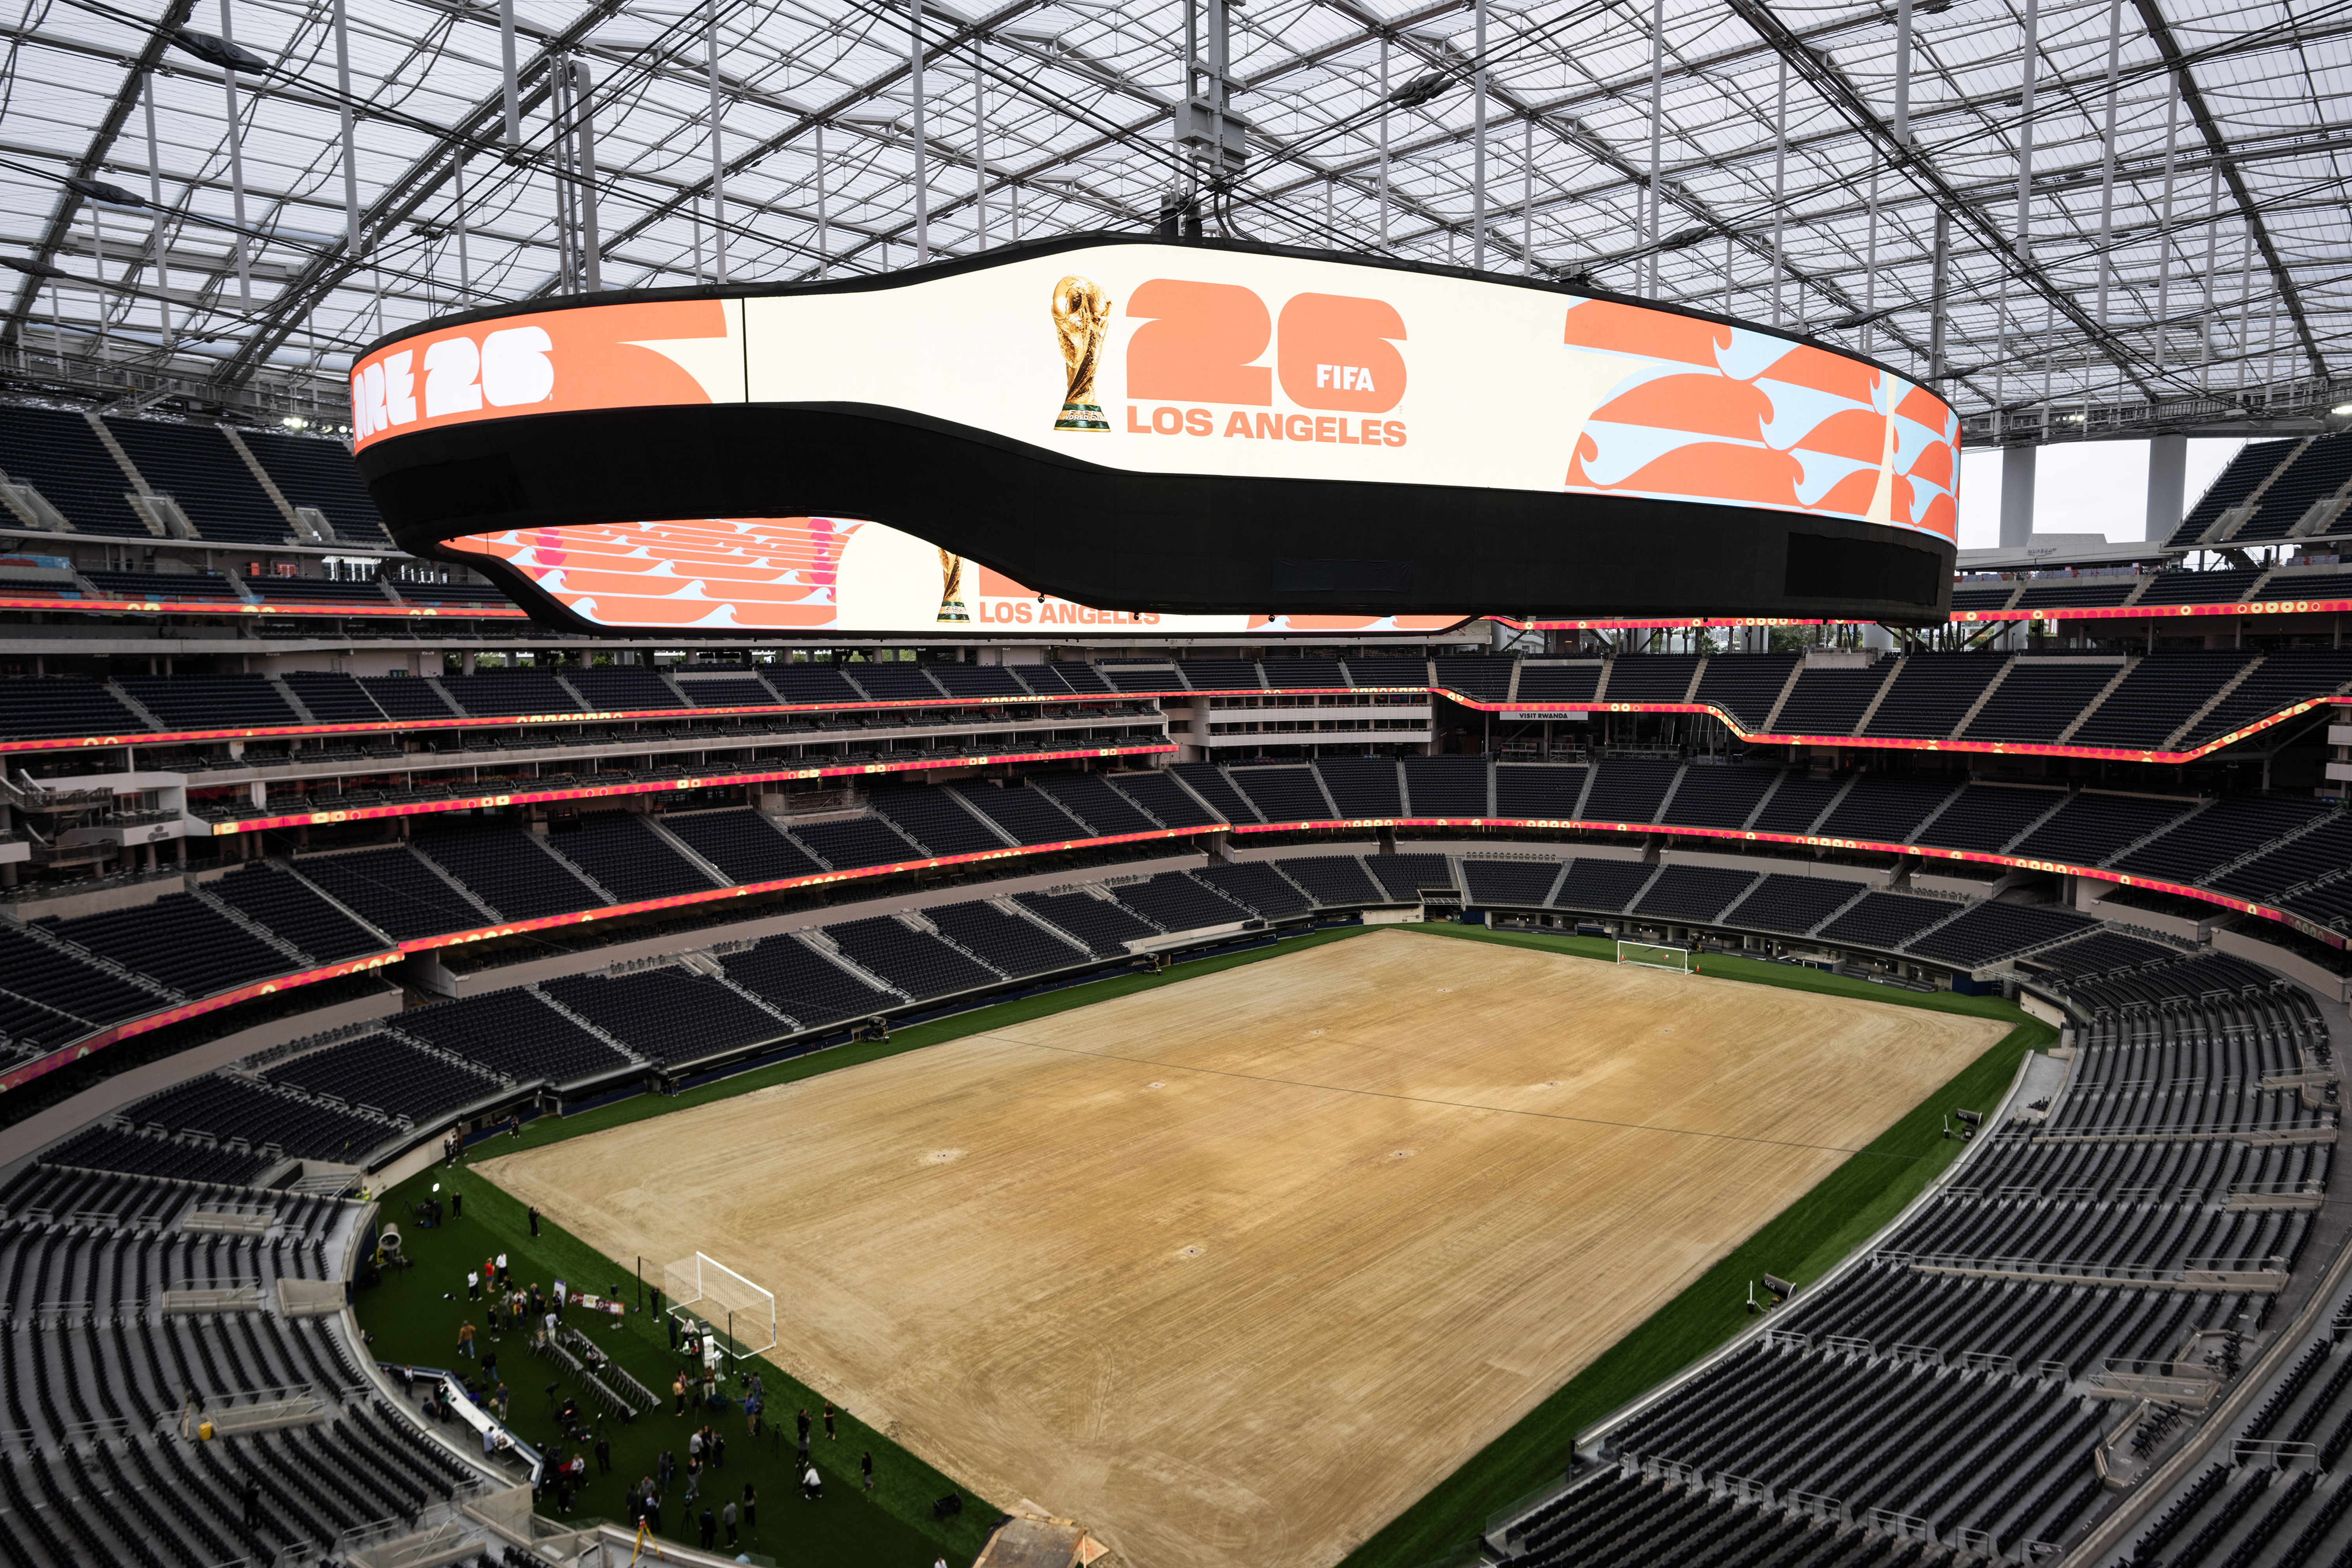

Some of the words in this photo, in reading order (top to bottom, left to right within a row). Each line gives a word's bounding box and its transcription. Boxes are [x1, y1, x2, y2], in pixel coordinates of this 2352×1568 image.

[1125, 278, 1407, 414] 26
[354, 349, 417, 442] ARE
[423, 326, 554, 418] 26
[1317, 364, 1375, 392] FIFA
[1127, 405, 1213, 437] LOS
[1223, 411, 1406, 447] ANGELES
[980, 602, 1032, 624] LOS
